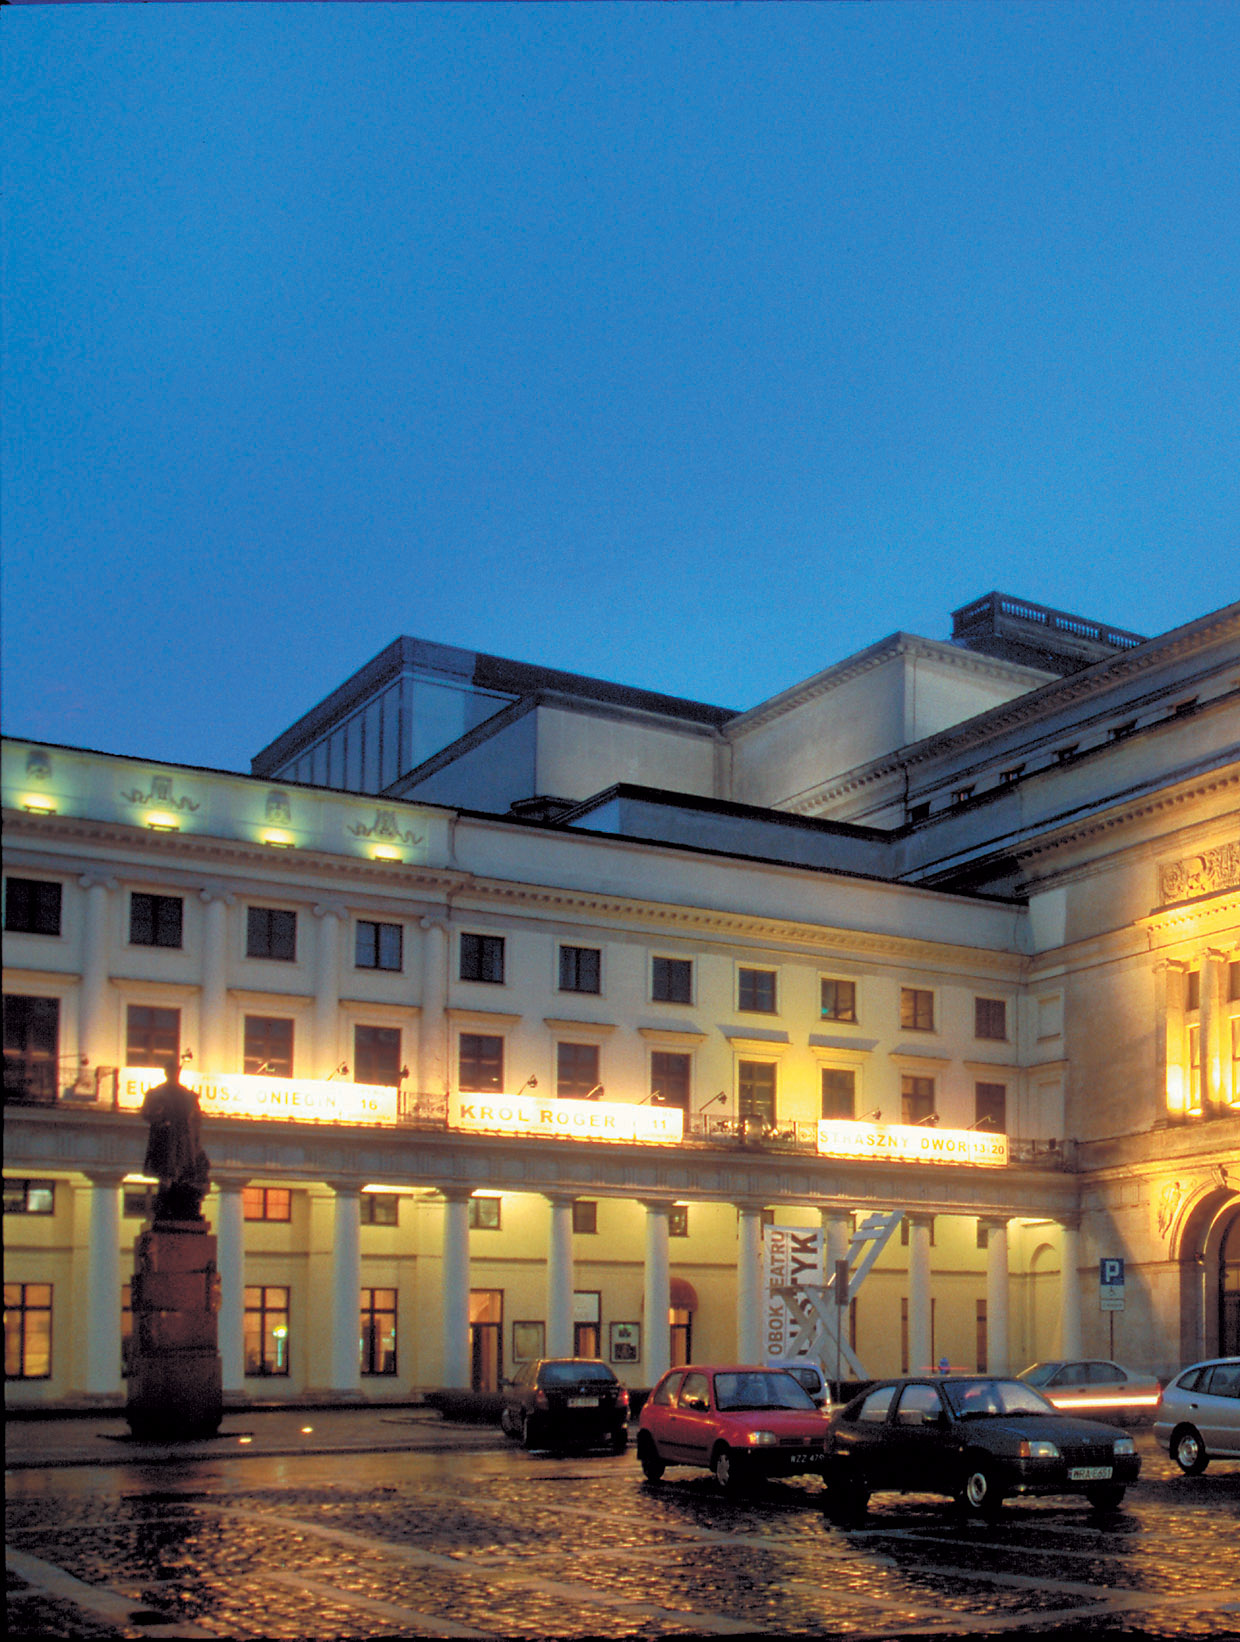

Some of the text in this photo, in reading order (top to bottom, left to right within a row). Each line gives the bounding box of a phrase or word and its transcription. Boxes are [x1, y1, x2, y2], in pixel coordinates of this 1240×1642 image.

[539, 1109, 616, 1128] ROGER
[652, 1119, 667, 1129] 11
[819, 1130, 909, 1149] STRASZNY
[1105, 1260, 1120, 1282] P
[768, 1230, 786, 1356] OBOK TEATRU
